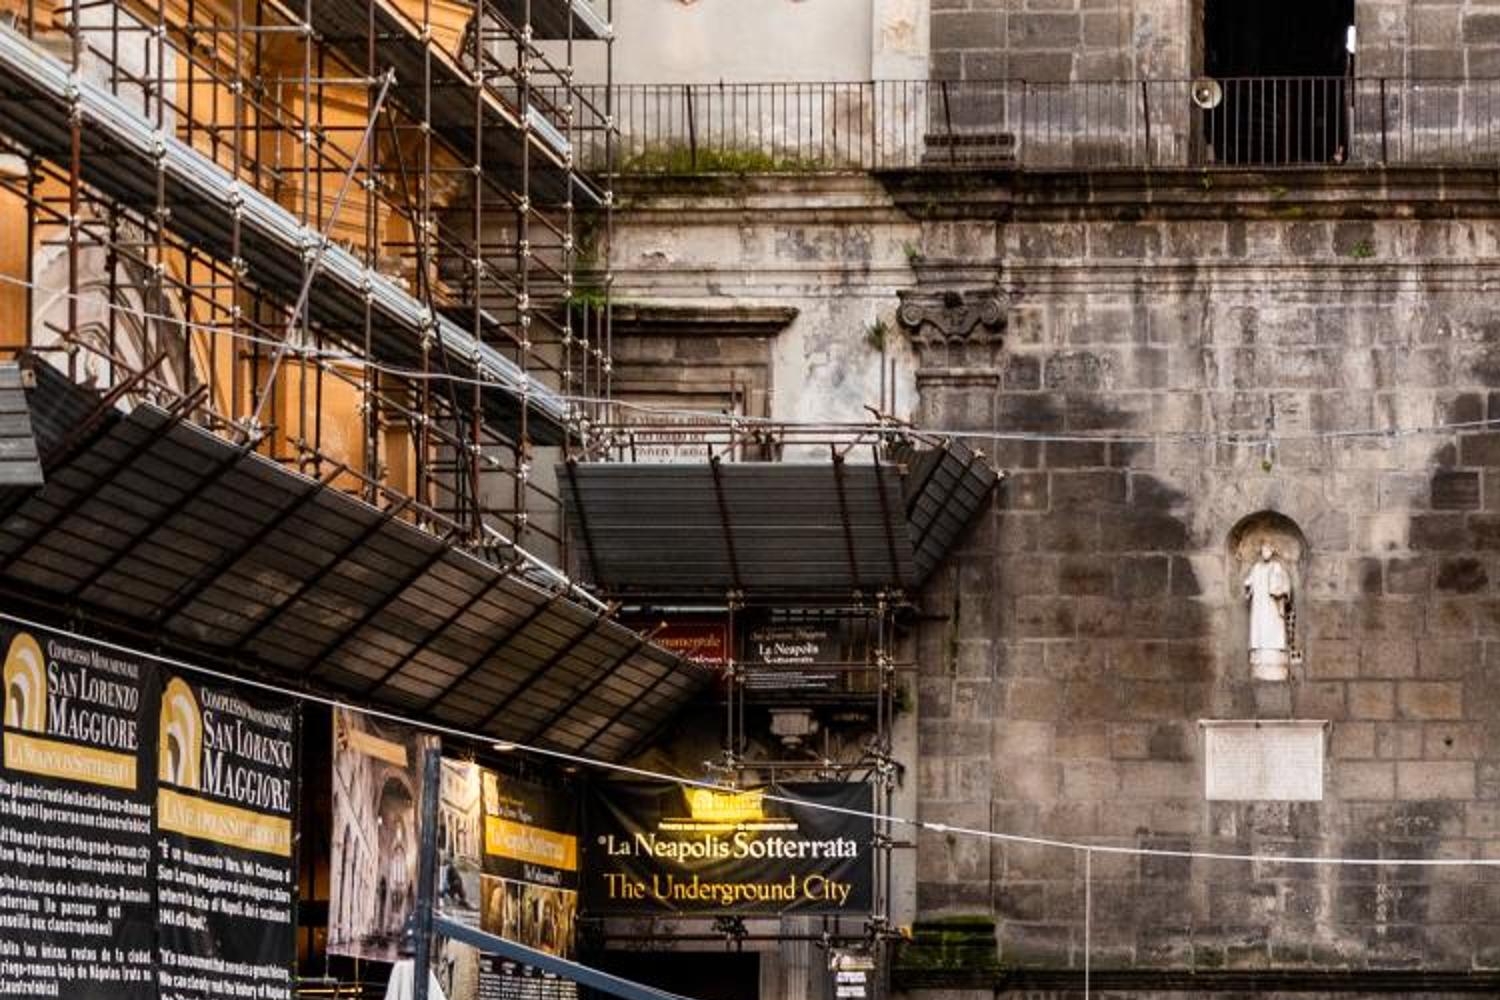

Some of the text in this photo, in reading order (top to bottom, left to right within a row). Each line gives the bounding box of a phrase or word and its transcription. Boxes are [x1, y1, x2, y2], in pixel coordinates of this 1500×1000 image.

[47, 693, 139, 750] MAGGIORE
[202, 748, 291, 813] MAGGIORE
[608, 832, 858, 862] La Neapolis Sotterrata
[603, 873, 851, 906] The Underground City
